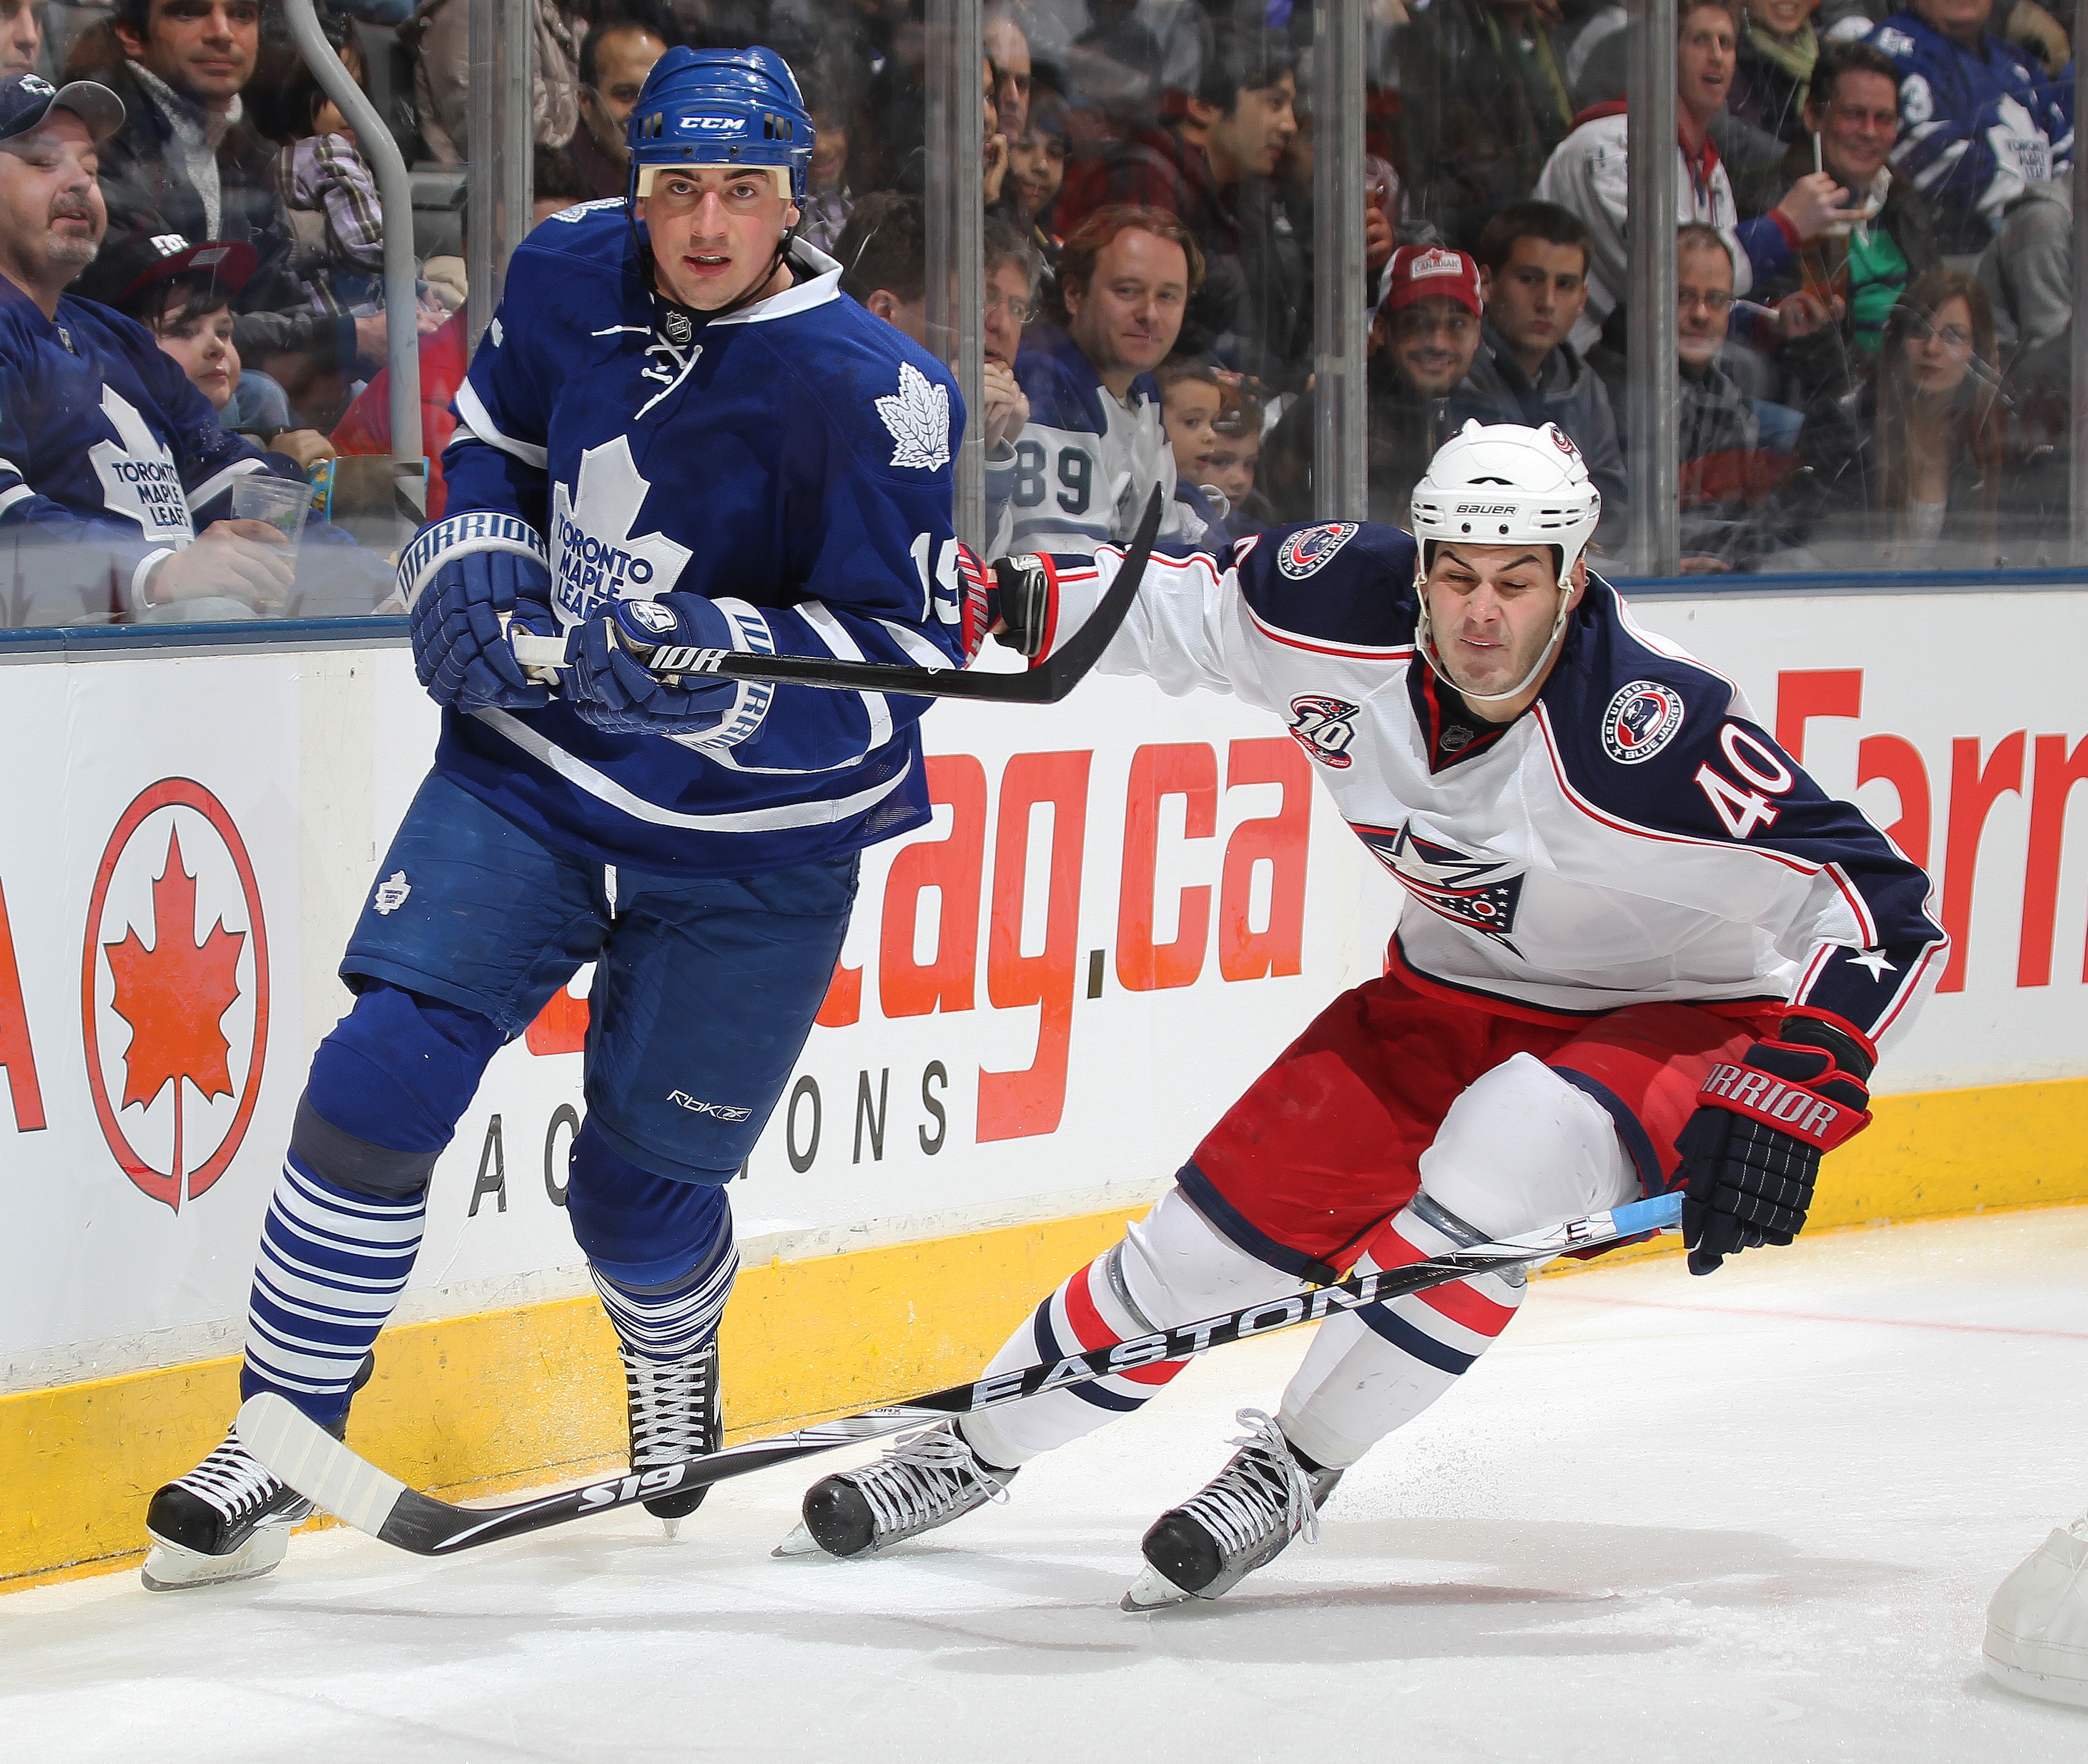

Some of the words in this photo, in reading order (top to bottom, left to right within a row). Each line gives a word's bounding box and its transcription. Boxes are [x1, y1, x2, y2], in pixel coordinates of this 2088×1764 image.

[680, 117, 746, 129] CCM
[1013, 440, 1093, 515] 89
[148, 506, 188, 527] LEAF
[1456, 505, 1516, 515] BAUER
[399, 514, 544, 602] WARRIOR
[559, 513, 653, 585] TORONTO
[559, 549, 625, 604] MAPLE
[1606, 684, 1652, 743] COLUMBUS
[1625, 739, 1660, 760] BLUE
[1692, 721, 1796, 840] 40
[971, 1275, 1378, 1411] EASTON
[577, 1464, 686, 1513] S19
